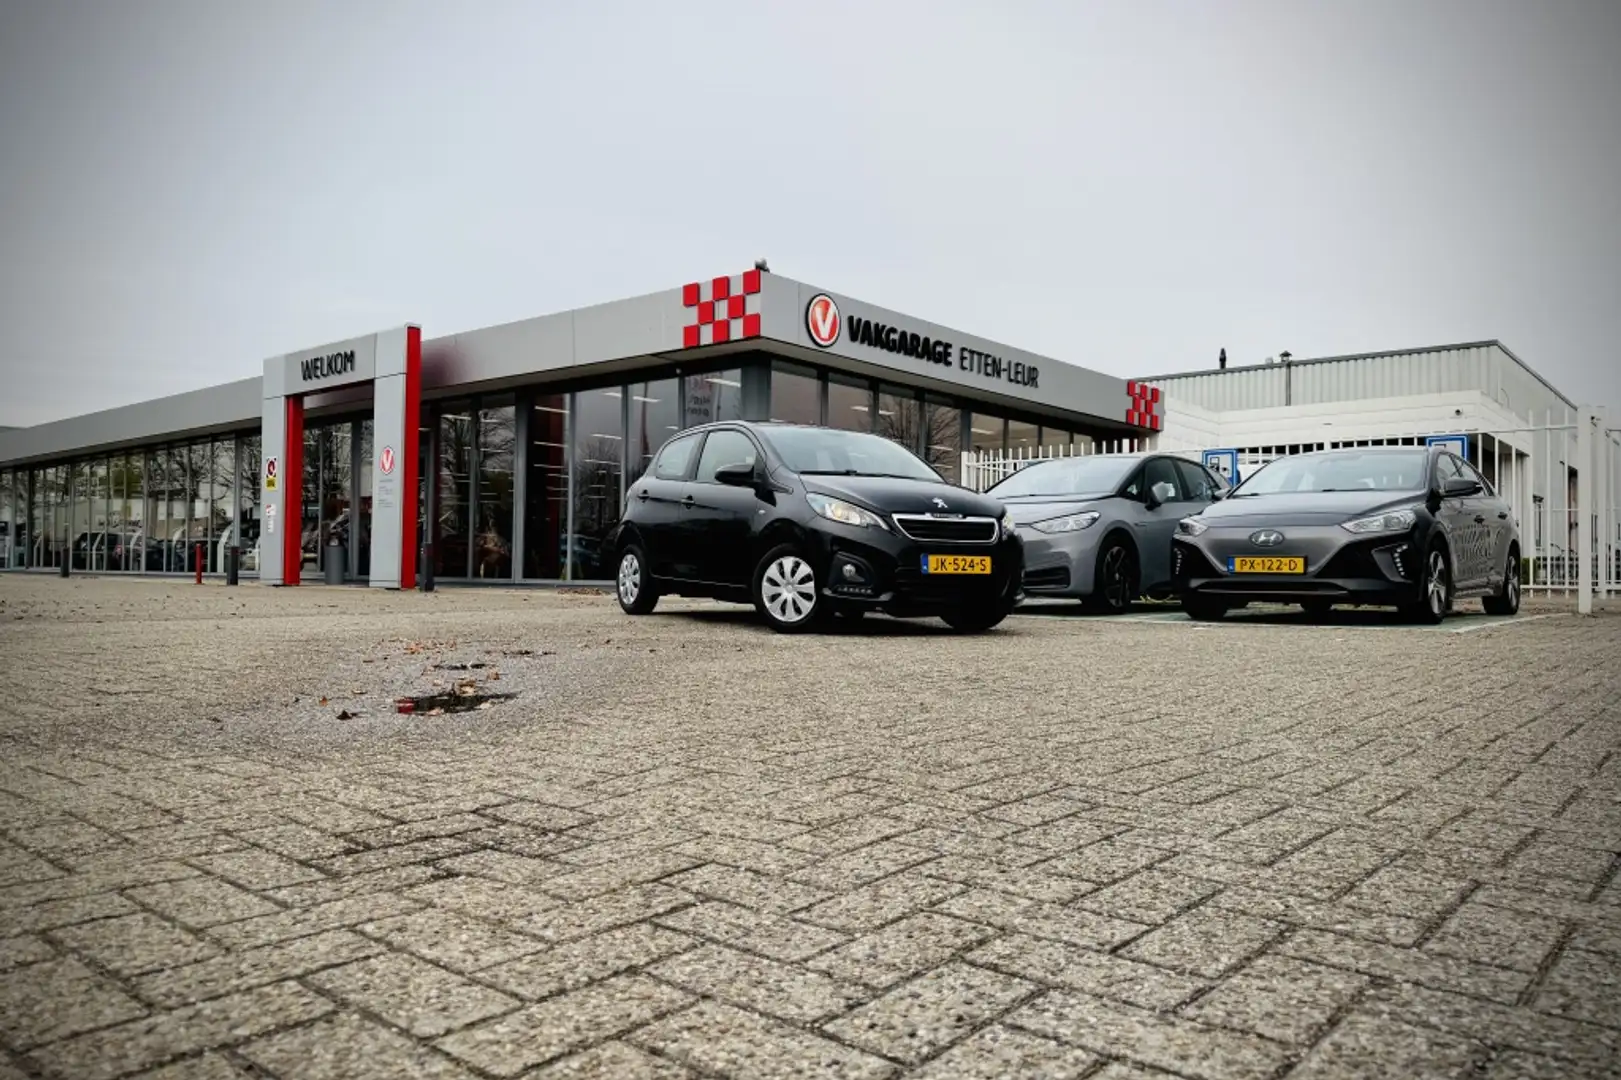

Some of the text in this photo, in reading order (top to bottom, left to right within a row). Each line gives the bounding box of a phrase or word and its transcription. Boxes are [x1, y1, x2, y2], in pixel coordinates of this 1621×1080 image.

[847, 315, 1040, 389] VAKGARAGE ETTEN-LEUR
[301, 350, 355, 381] WELKOM
[933, 557, 987, 571] JK-524-S
[1240, 559, 1298, 571] PX-122-D
